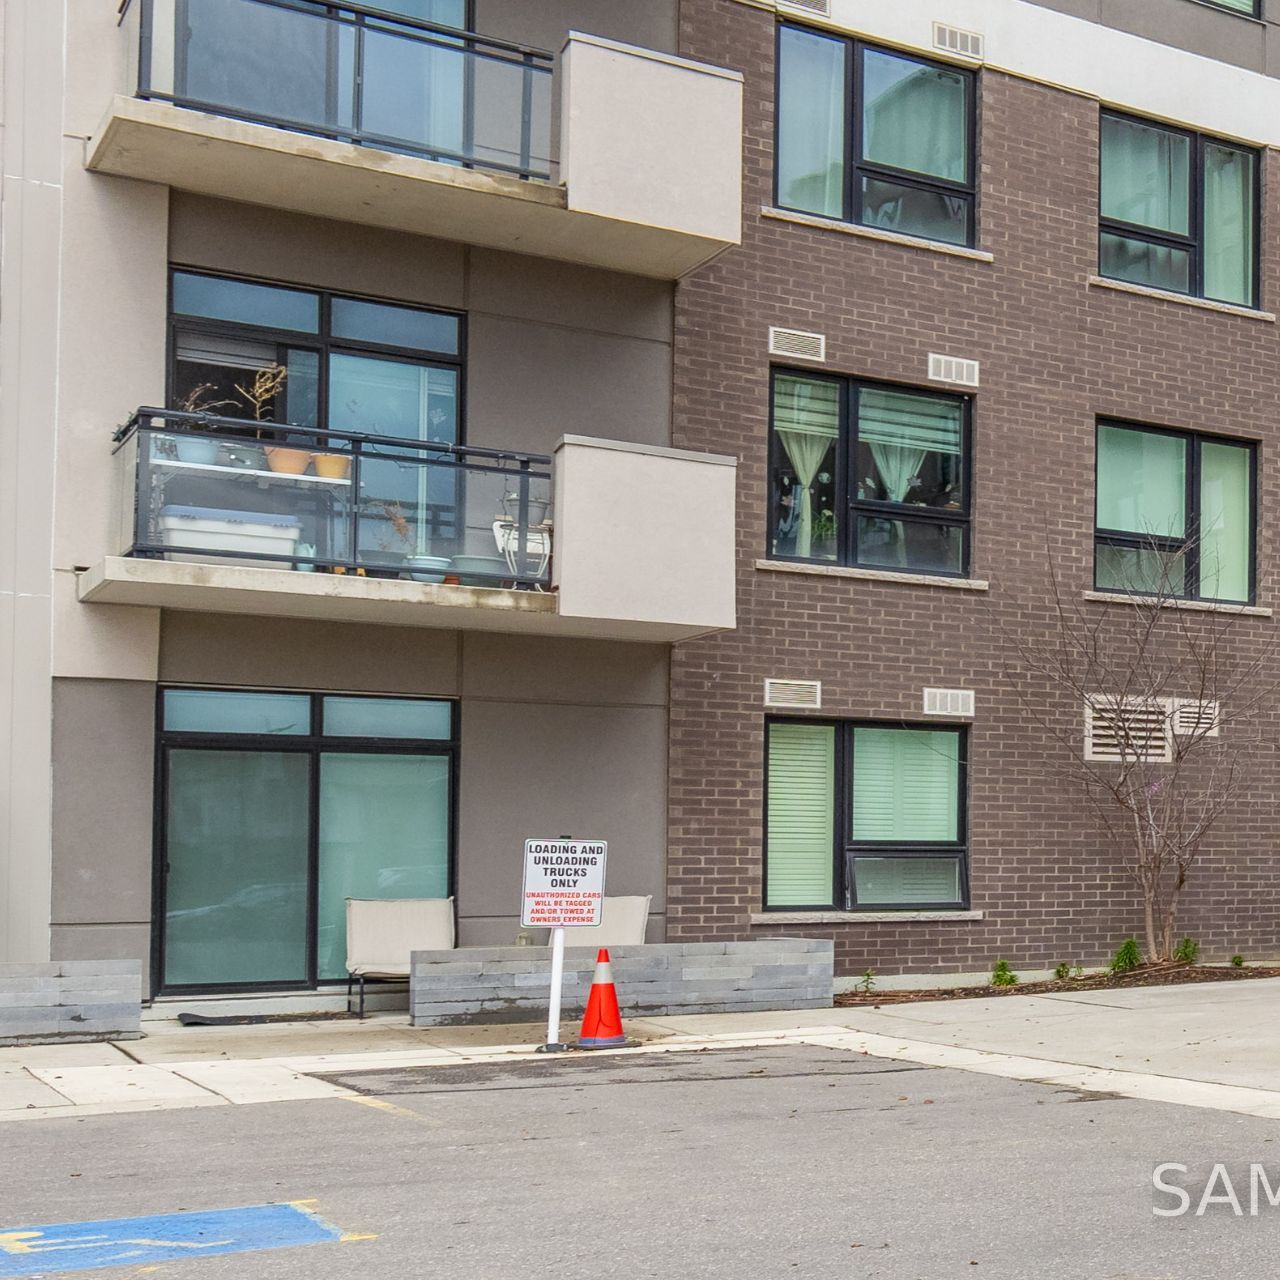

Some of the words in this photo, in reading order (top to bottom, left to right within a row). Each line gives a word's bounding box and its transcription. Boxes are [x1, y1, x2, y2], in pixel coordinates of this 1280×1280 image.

[529, 844, 577, 854] LOADING
[581, 846, 603, 855] AND
[534, 856, 598, 866] UNLOADING
[543, 867, 588, 877] TRUCKS
[551, 878, 579, 888] ONLY
